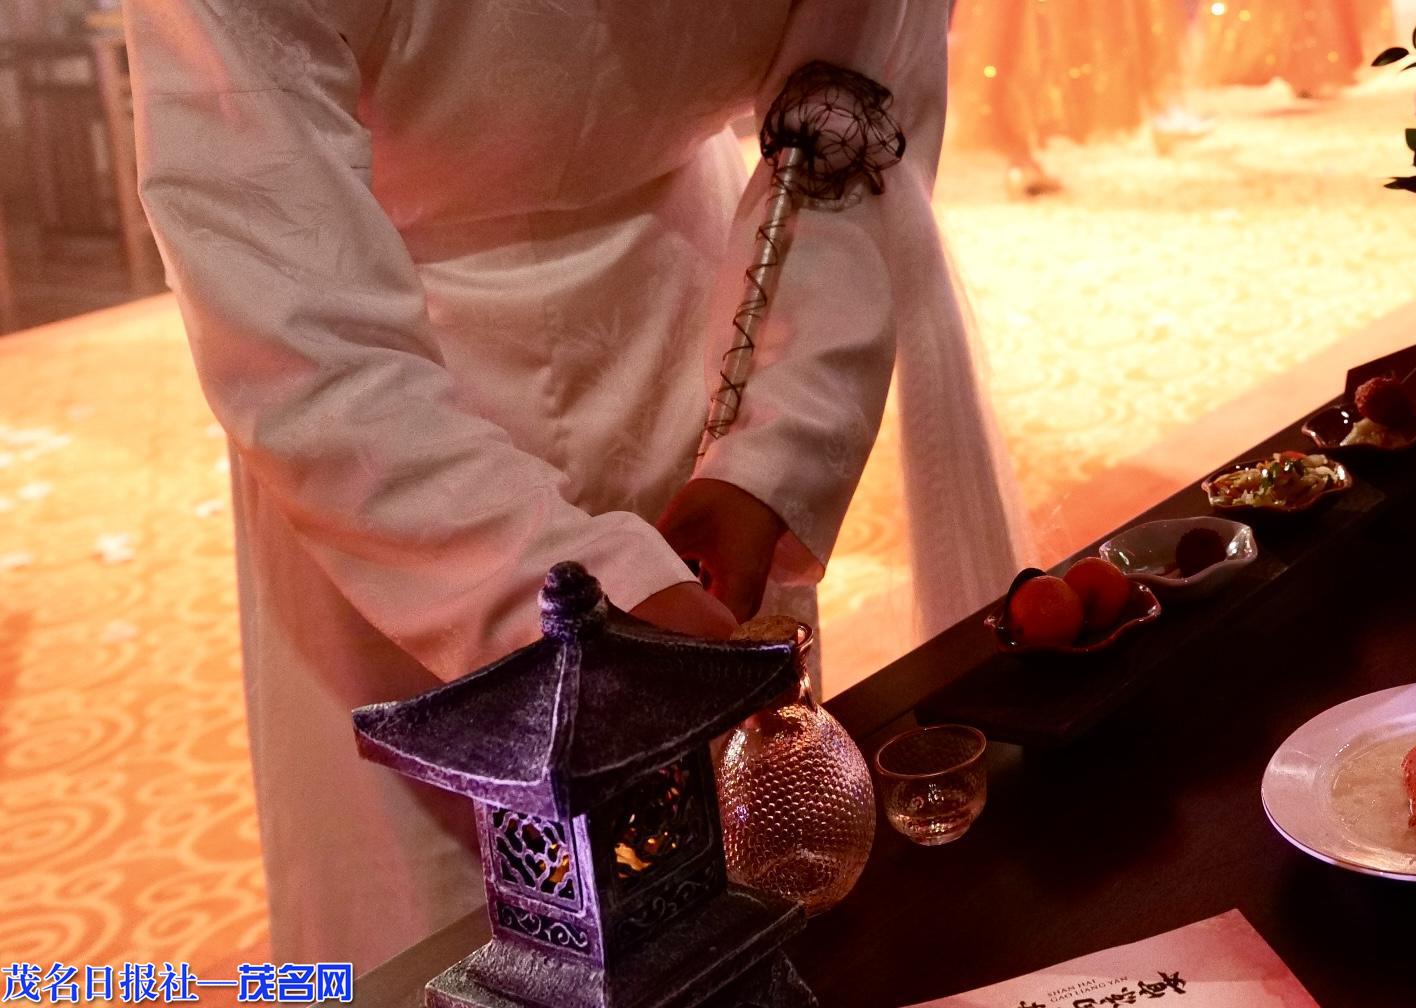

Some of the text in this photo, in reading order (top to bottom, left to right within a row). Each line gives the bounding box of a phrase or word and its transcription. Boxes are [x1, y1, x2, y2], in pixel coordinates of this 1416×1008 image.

[1047, 978, 1096, 997] SHAN HAI
[1108, 976, 1128, 985] YAN
